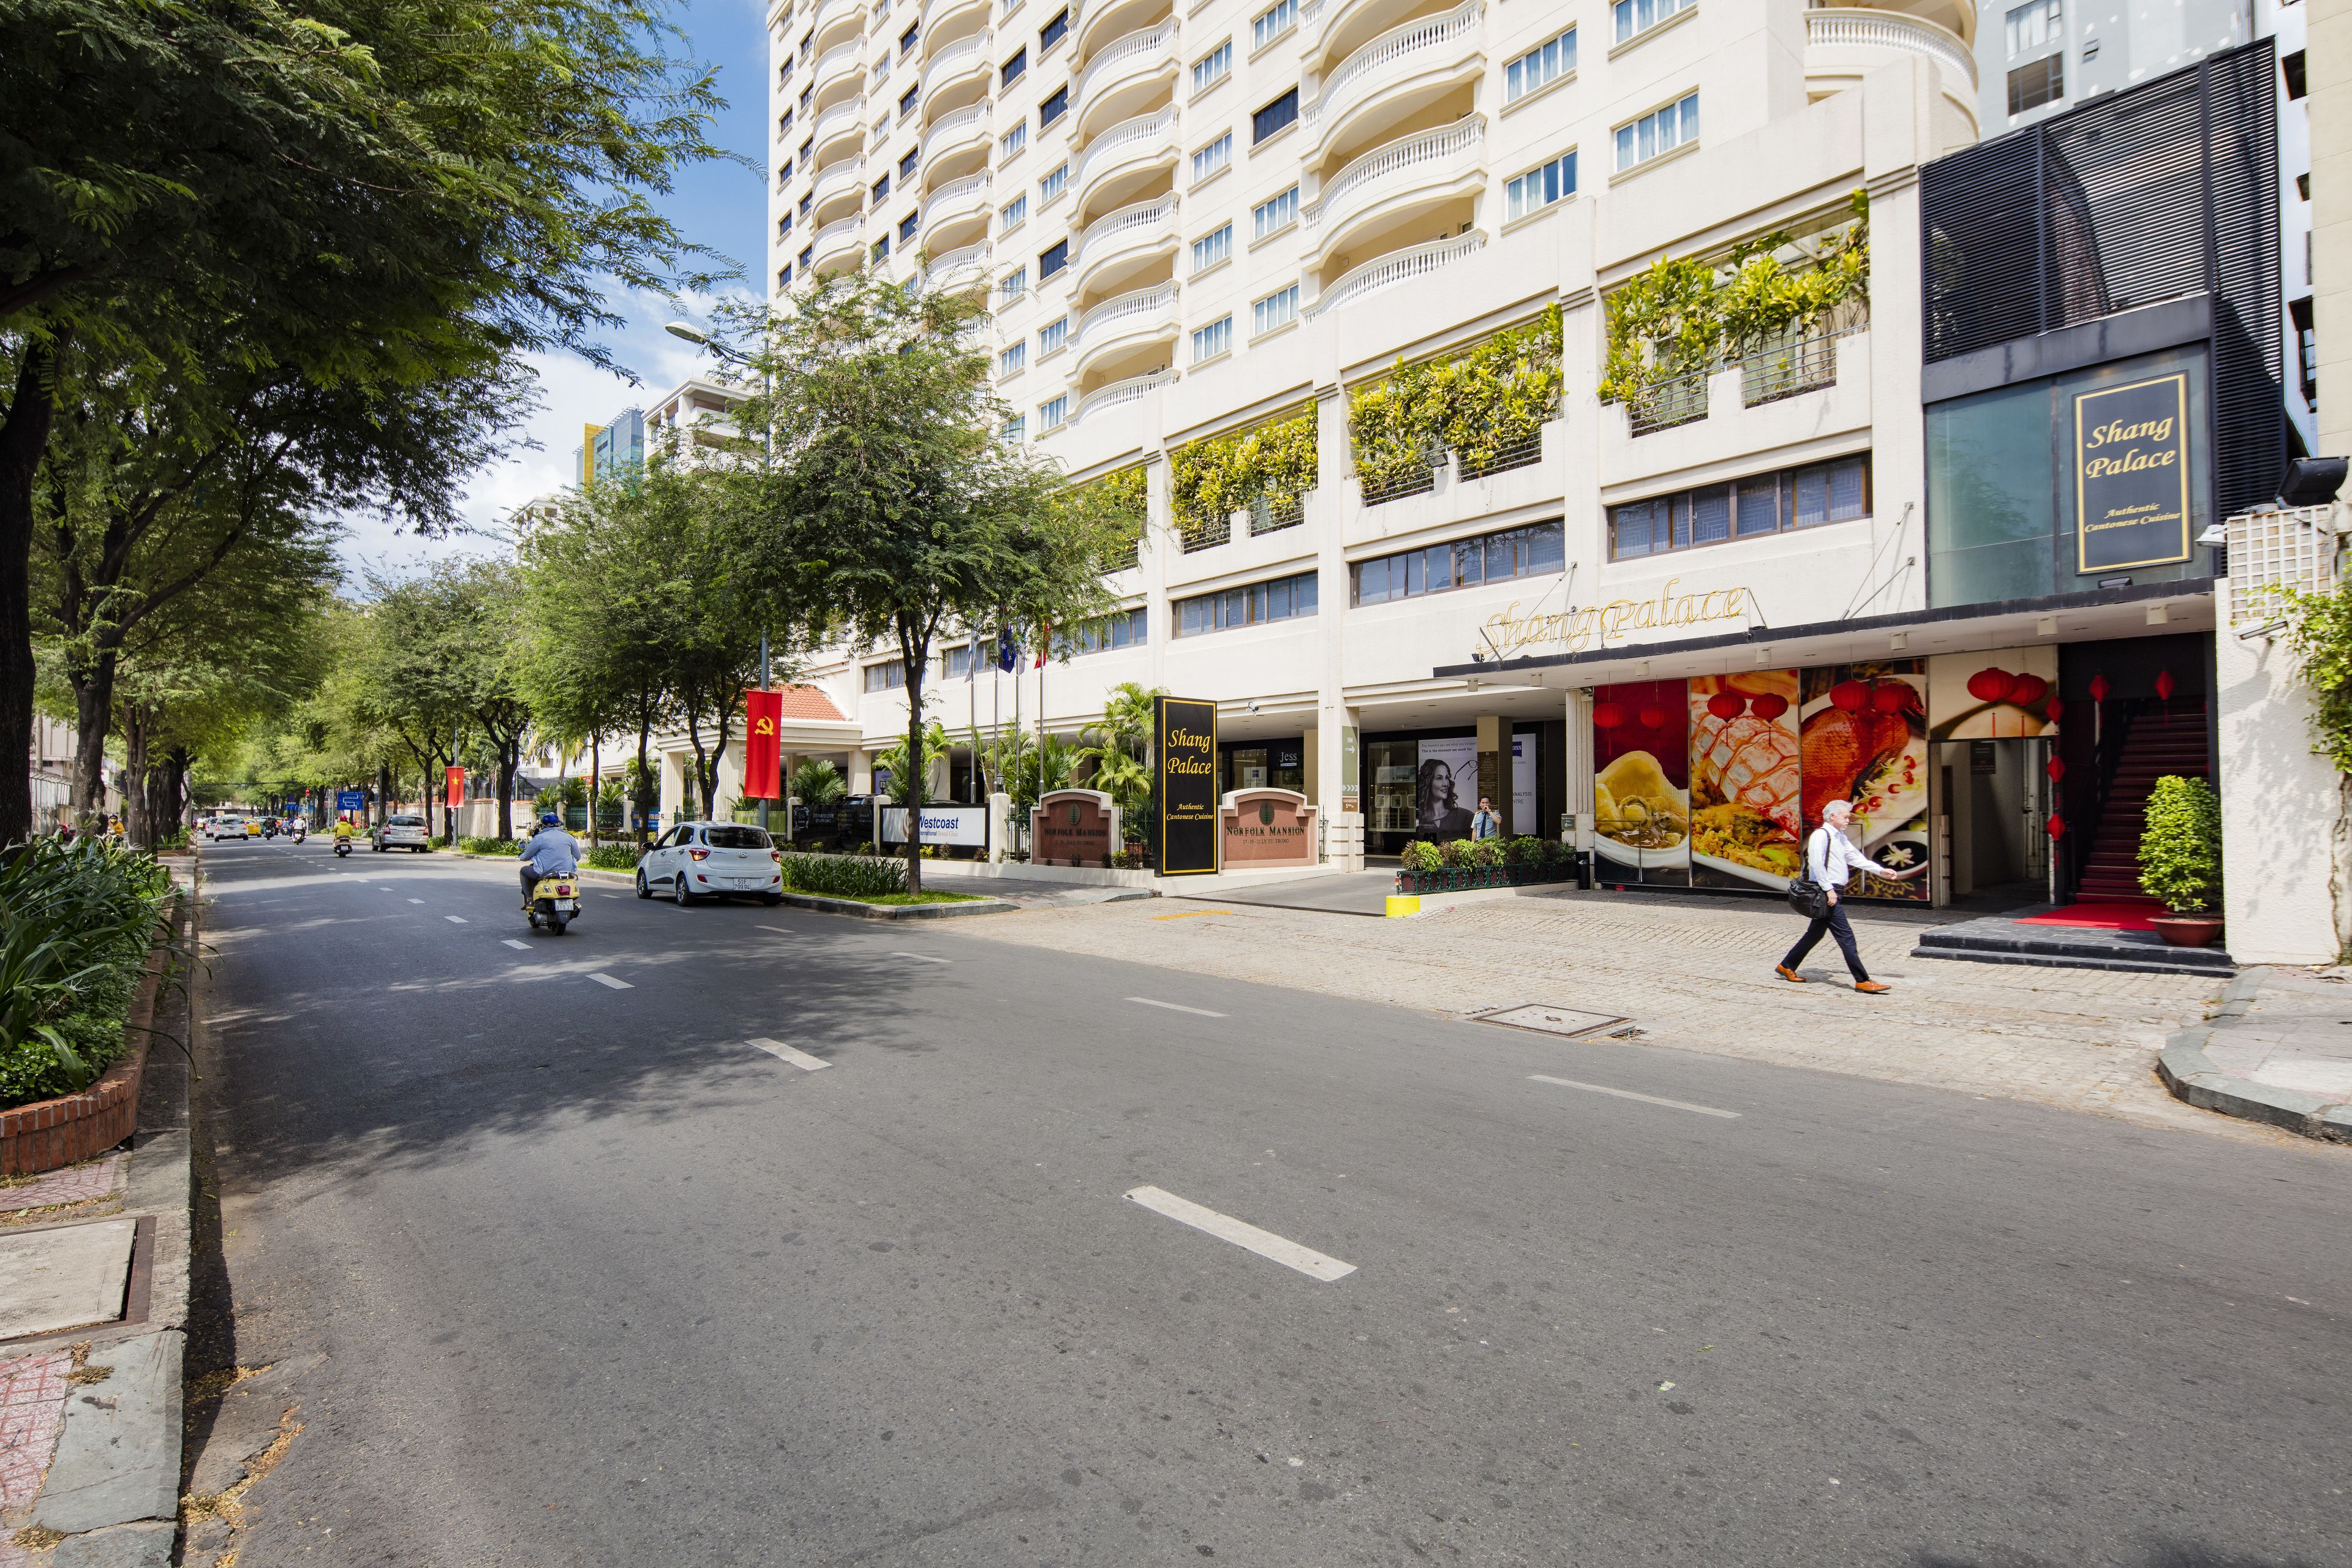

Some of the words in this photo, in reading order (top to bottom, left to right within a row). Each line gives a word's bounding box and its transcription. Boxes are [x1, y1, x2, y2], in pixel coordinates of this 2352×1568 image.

[2086, 417, 2174, 448] Shang
[2086, 448, 2176, 478] Palace
[2103, 503, 2161, 519] Authentic
[2084, 519, 2139, 532] Cantonese
[2140, 512, 2182, 525] Cuisine
[1476, 600, 1597, 655] Shang
[1600, 578, 1744, 639] Palace
[1168, 728, 1211, 753] Shang
[1167, 755, 1212, 774] Palace
[1280, 752, 1297, 763] Jess
[1177, 802, 1204, 811] Authentic
[1044, 827, 1073, 836] NORFOLK
[1076, 828, 1107, 837] MANSION
[1227, 826, 1265, 837] NORFOLK
[1269, 826, 1305, 836] MANSION
